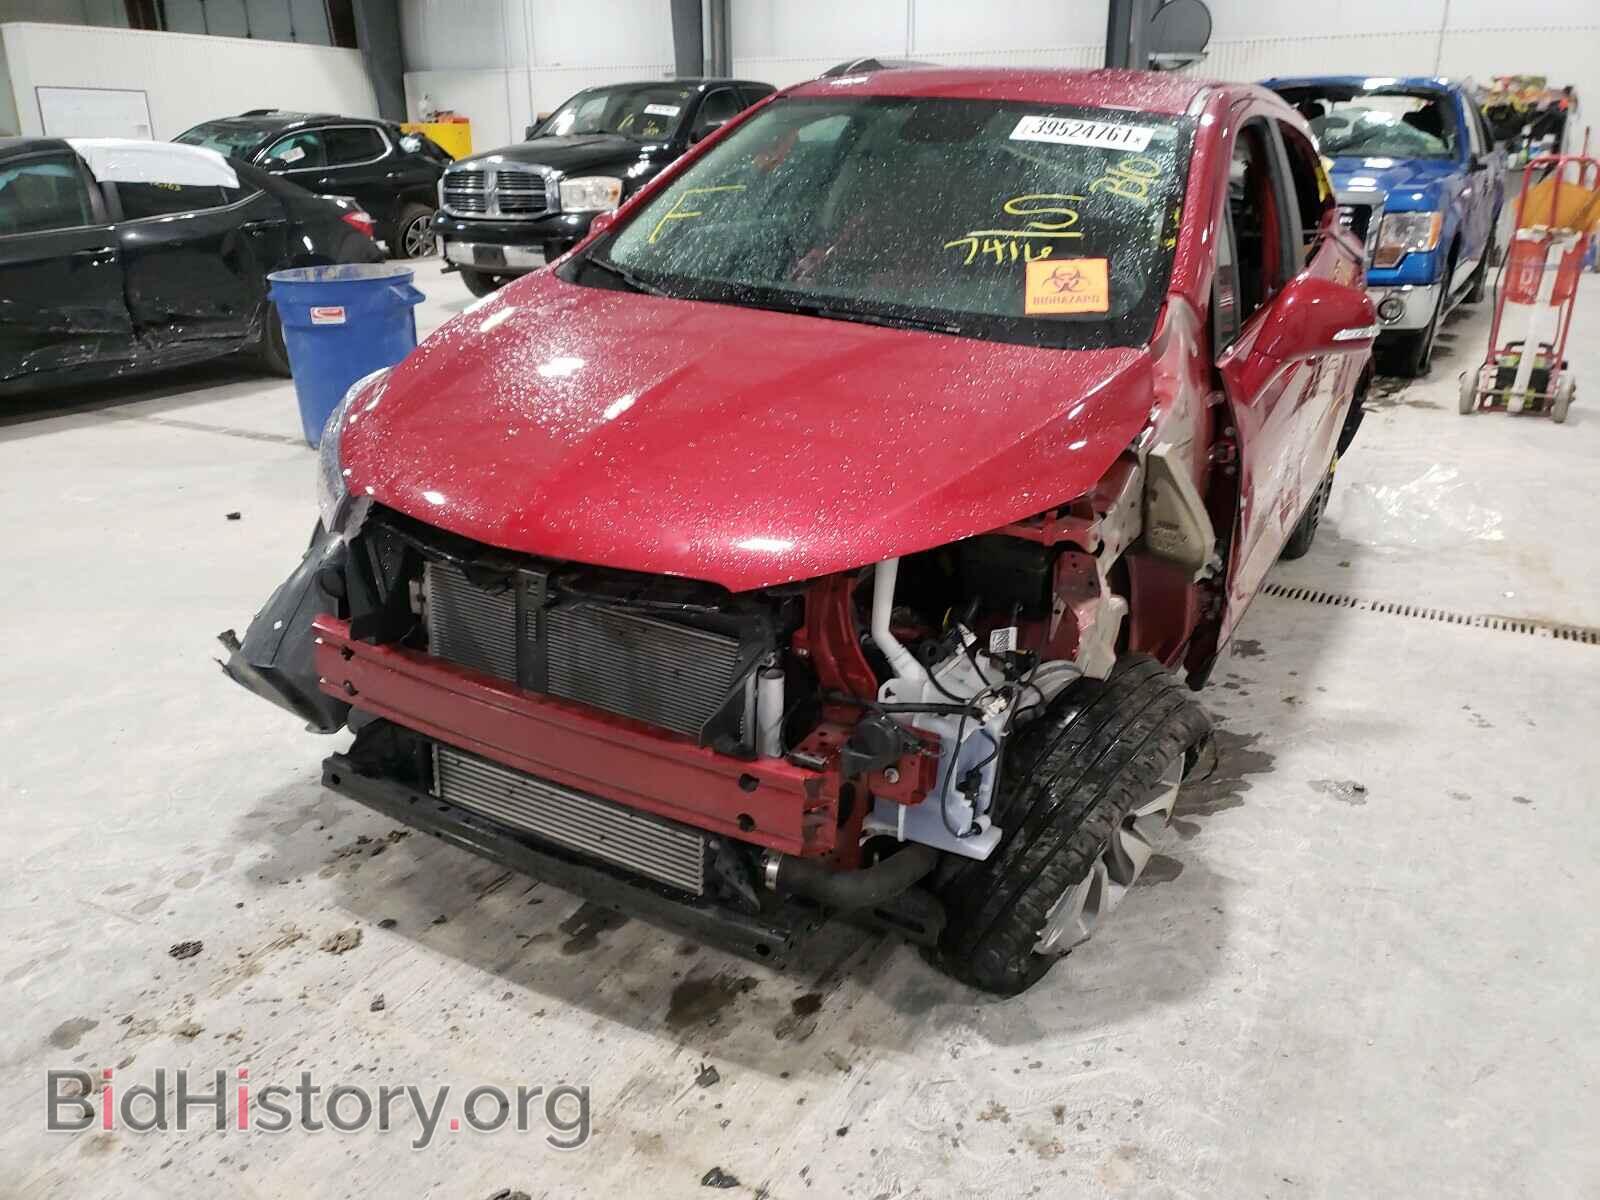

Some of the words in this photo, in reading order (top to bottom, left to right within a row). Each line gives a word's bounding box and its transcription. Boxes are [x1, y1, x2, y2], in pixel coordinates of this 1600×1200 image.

[1031, 118, 1134, 143] 39524761
[648, 184, 747, 244] F
[1003, 193, 1086, 230] S
[1033, 295, 1100, 305] BIOHAZARD
